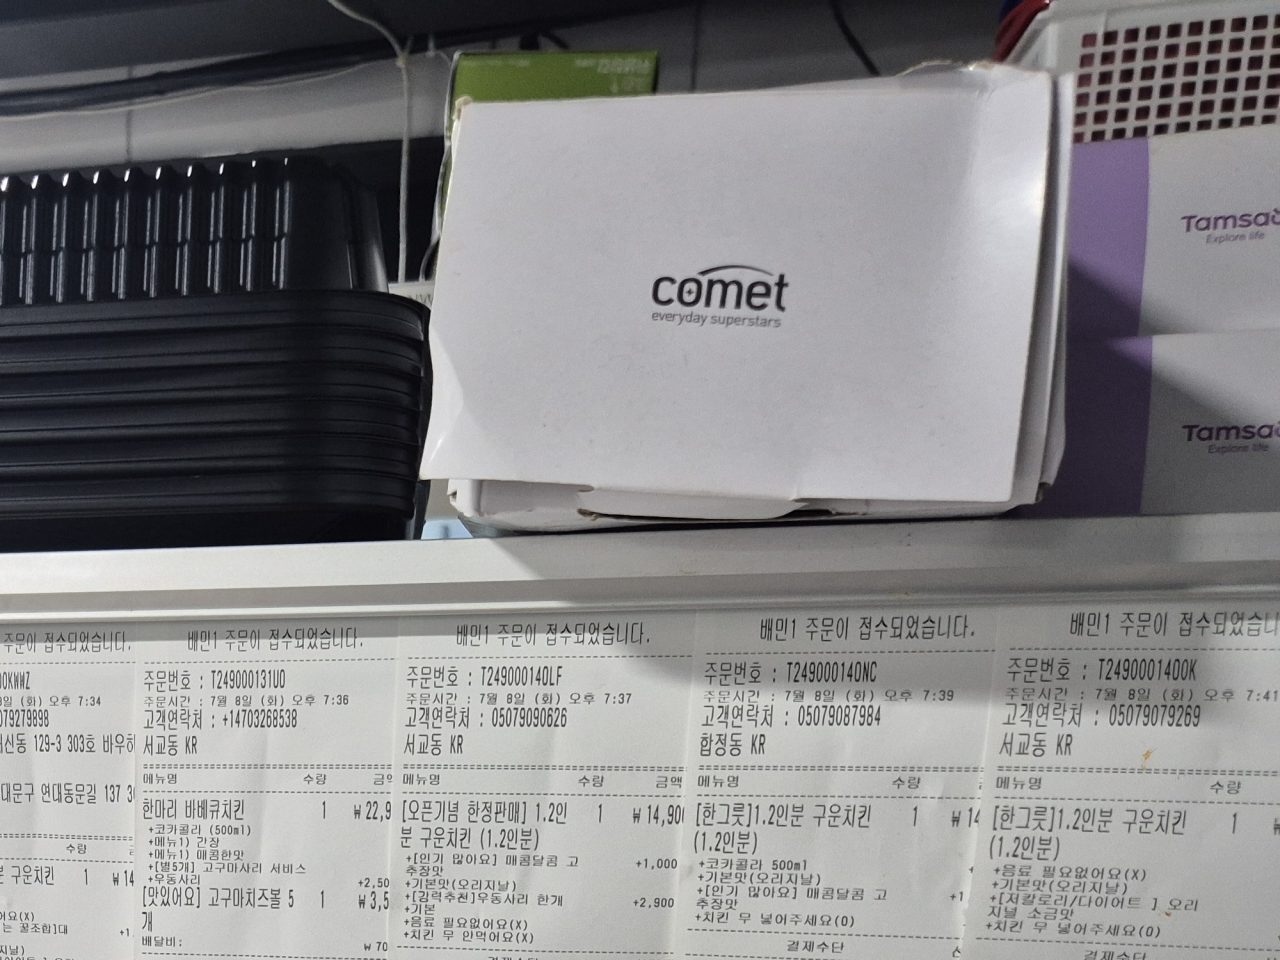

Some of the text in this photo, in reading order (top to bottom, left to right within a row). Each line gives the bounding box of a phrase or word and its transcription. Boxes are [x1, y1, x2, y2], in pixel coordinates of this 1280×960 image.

[652, 274, 789, 312] comet
[652, 312, 781, 328] everyday superstars
[1182, 421, 1280, 442] Tamsa
[760, 615, 975, 642] 배민1 주문이 접수되었습니다.
[1070, 612, 1110, 637] 배민1
[1120, 612, 1168, 638] 주문이
[4, 632, 36, 654] 주문이
[44, 630, 131, 654] 접수되었습니다.
[188, 628, 364, 652] 배민1 주문이 접수되었습니다.
[407, 666, 459, 689] 주문번호
[705, 662, 762, 686] 주문번호
[785, 689, 954, 703] 7월 8일 (화) 오후 7:39
[403, 774, 683, 788] 메뉴명 수량 금액
[142, 799, 244, 820] 한마리 바베큐치킨
[402, 801, 568, 824] [오픈기념 한정판매] 1.2인
[696, 804, 871, 828] [한그릇]1.2인분 구운치킨
[992, 805, 1186, 836] [한그릇]1.2인분 구운치킨
[420, 827, 540, 851] 구운치킨 (1.2인분)
[202, 862, 262, 874] 고구마사리
[270, 863, 306, 874] 서비스
[506, 855, 558, 868] 매콤달콤
[635, 857, 678, 870] +1,000
[142, 887, 281, 909] [맛있어요] 고구마치즈볼
